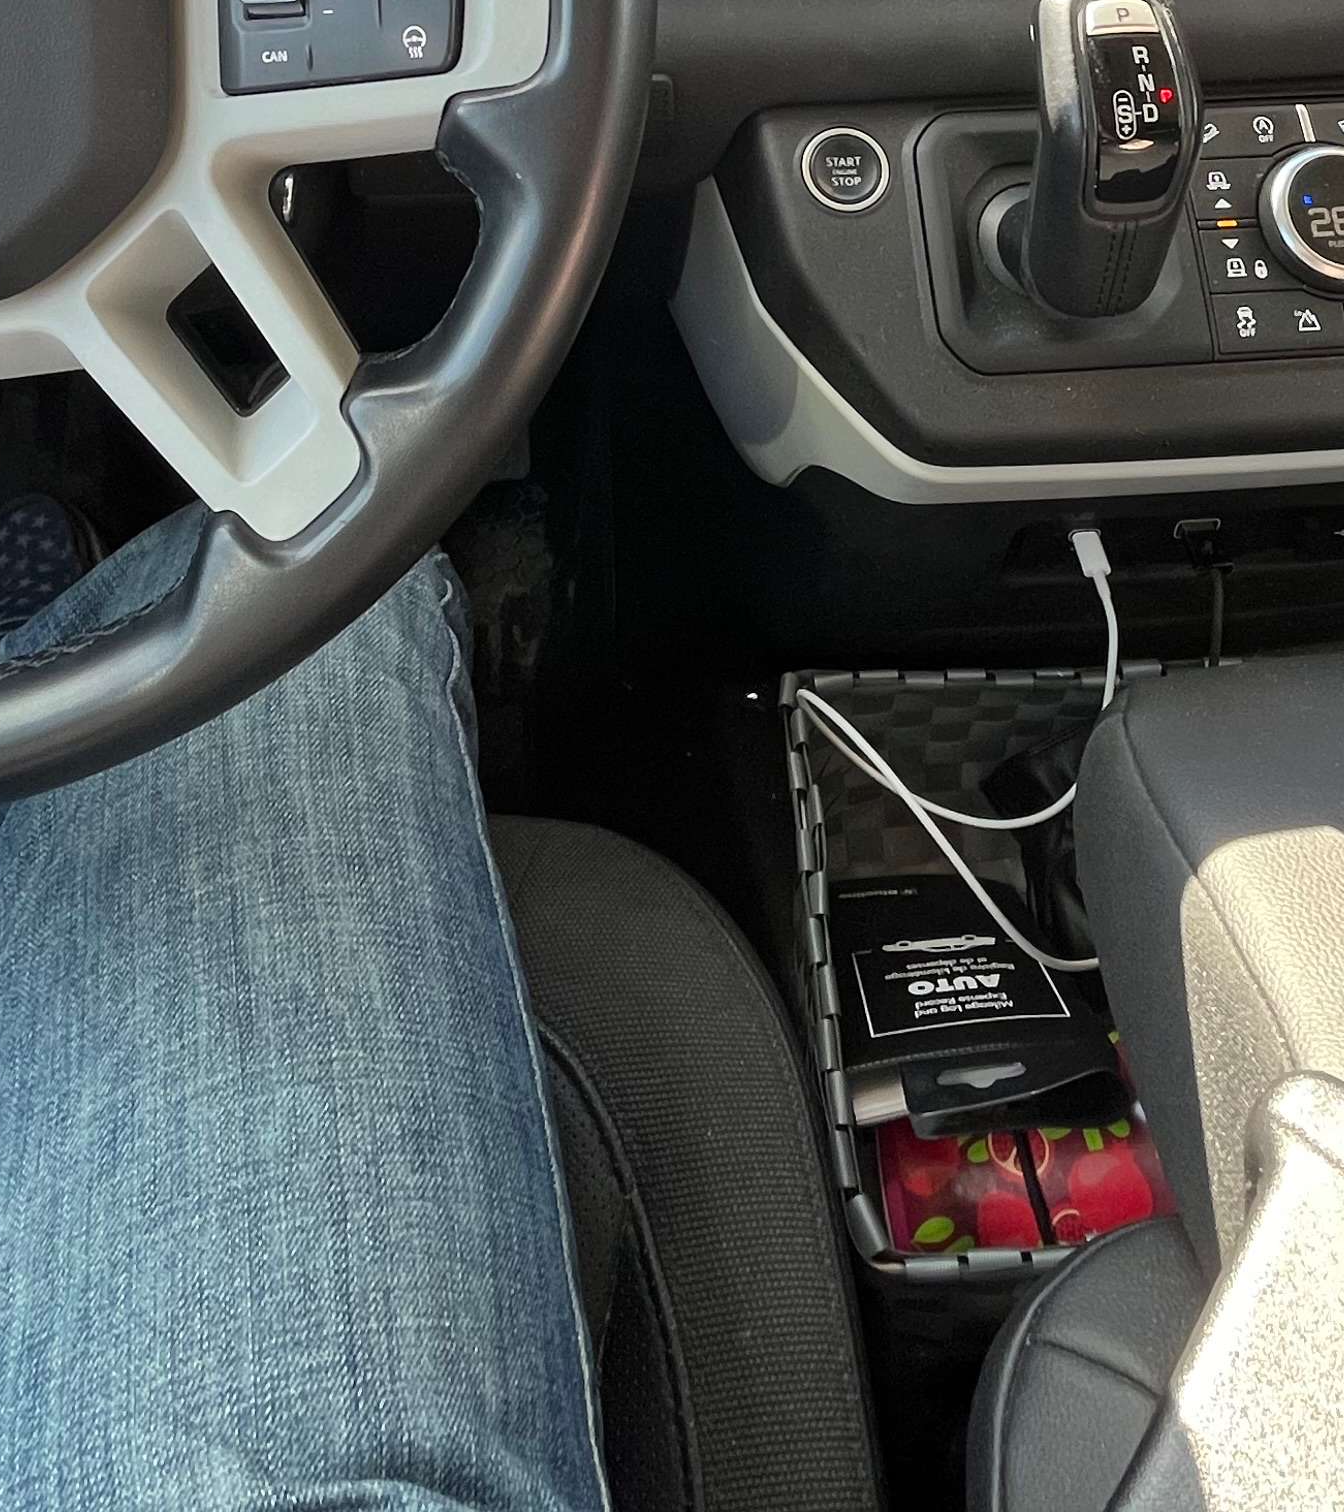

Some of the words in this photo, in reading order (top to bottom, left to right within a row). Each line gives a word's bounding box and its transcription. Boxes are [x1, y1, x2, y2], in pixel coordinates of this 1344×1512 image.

[1116, 7, 1130, 23] P
[261, 50, 288, 64] CAN
[1132, 46, 1150, 65] R
[1137, 74, 1155, 93] N
[1117, 105, 1133, 123] S
[1142, 104, 1159, 123] D
[1258, 134, 1274, 143] OFF
[825, 156, 861, 168] START
[831, 176, 862, 187] STOP
[1239, 328, 1256, 338] OFF
[907, 972, 1001, 996] AUTO
[914, 997, 957, 1010] Record
[959, 991, 1007, 1004] Expense
[941, 1002, 963, 1015] Log
[964, 998, 1014, 1013] Mileage
[913, 1006, 938, 1019] and
